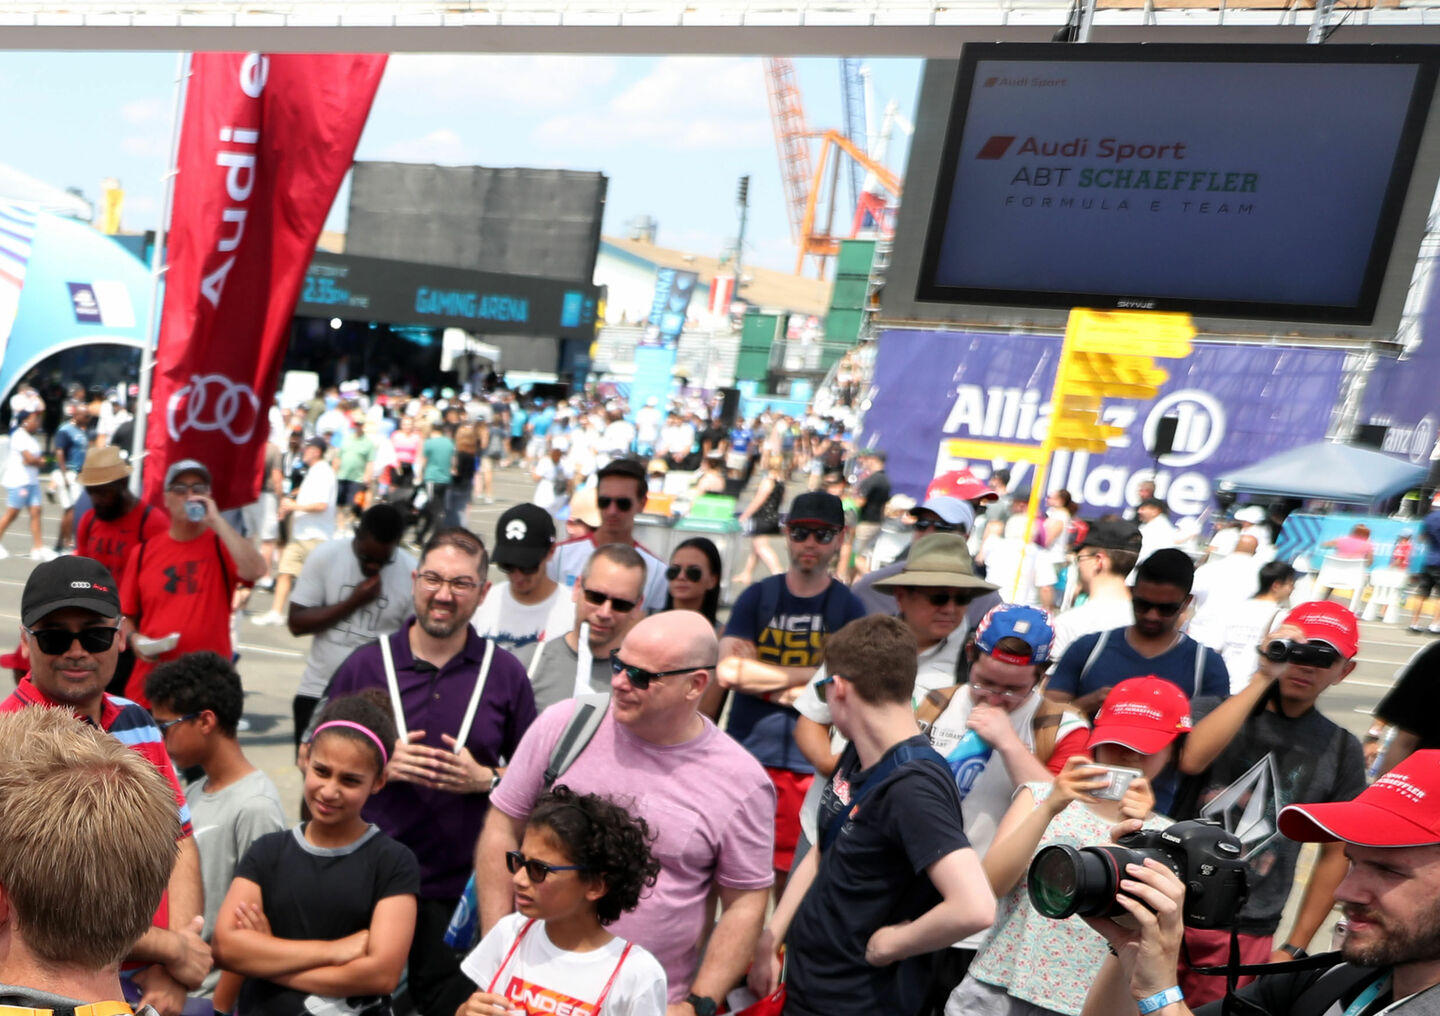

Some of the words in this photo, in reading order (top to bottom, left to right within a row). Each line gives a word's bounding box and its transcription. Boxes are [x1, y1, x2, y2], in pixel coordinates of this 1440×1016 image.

[998, 77, 1028, 87] Audi
[1031, 78, 1068, 89] Sport
[1016, 135, 1090, 158] Audi
[1095, 137, 1188, 164] Sport
[1010, 166, 1073, 188] ABT
[1077, 167, 1260, 194] SCHAEFFLER
[200, 126, 260, 309] Audi
[1005, 195, 1130, 211] FORMULA
[1149, 200, 1161, 212] E
[1181, 200, 1255, 215] TEAM
[477, 291, 530, 323] ARENA
